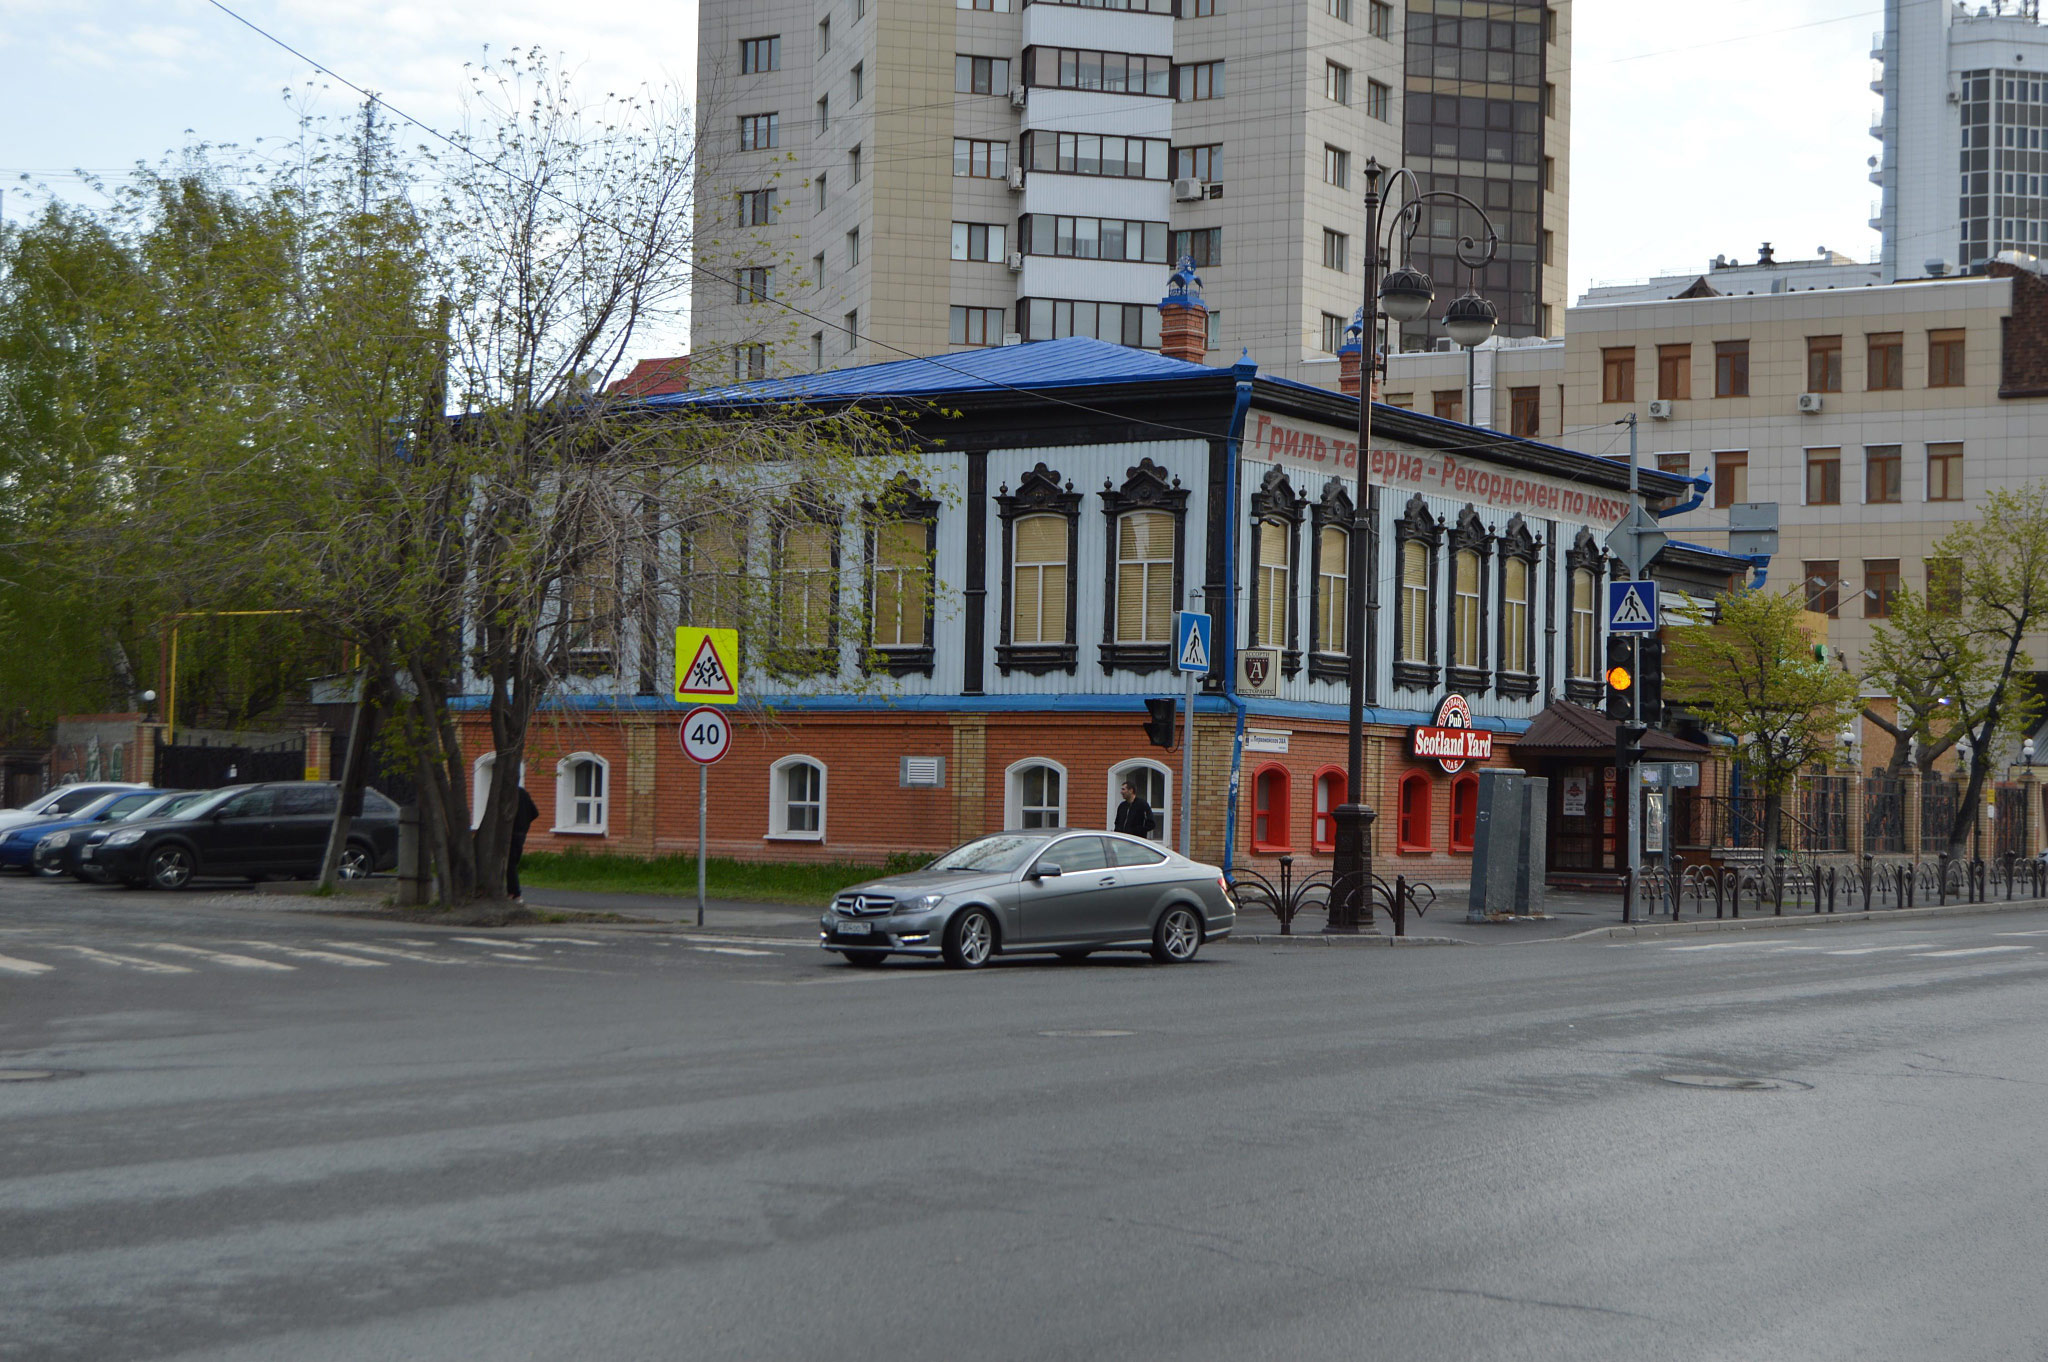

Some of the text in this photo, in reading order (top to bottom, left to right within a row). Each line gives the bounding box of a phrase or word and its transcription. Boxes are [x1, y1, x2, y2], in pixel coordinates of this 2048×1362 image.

[1255, 414, 1327, 462] Гриль
[1333, 439, 1423, 484] таерна
[1440, 456, 1560, 509] Рекордсмен
[1562, 490, 1584, 515] по
[1447, 713, 1462, 727] Pub
[691, 723, 720, 745] 40
[1415, 728, 1492, 758] Scotland Yard
[1446, 760, 1459, 770] ПАБ
